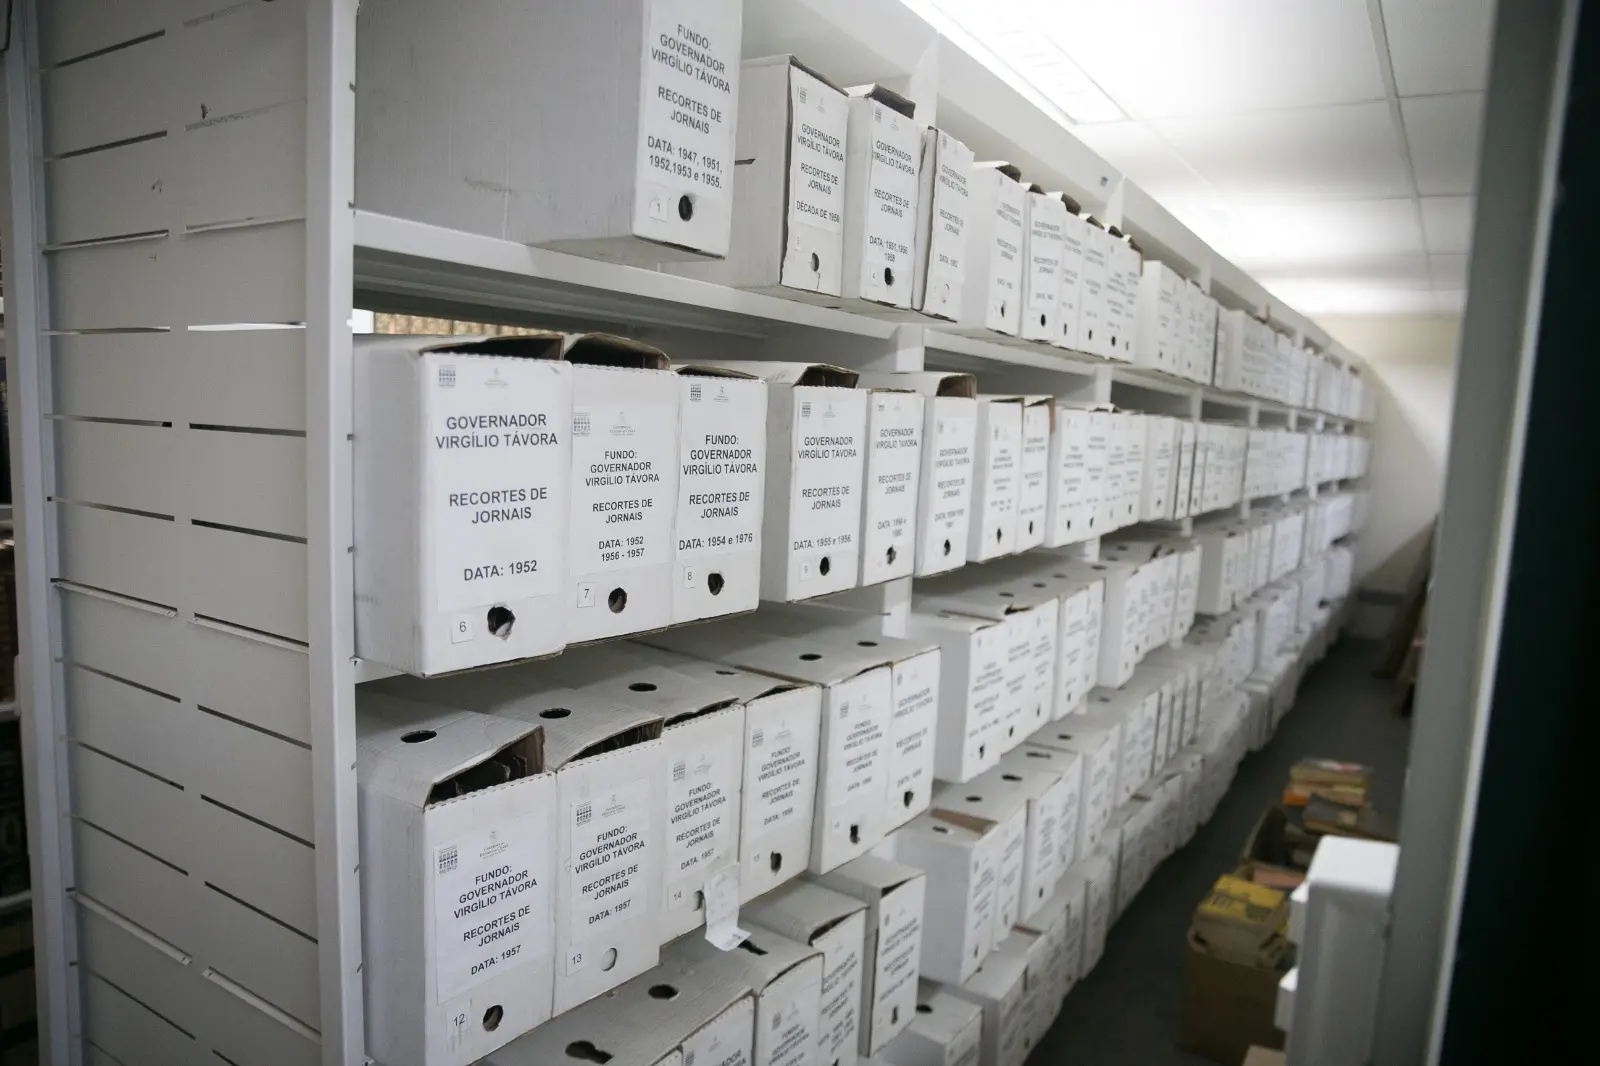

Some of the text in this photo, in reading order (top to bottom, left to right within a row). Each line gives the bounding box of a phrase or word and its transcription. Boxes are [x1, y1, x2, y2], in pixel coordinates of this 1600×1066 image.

[678, 24, 711, 51] FUNDO:
[660, 34, 724, 75] GOVERNADOR
[651, 47, 730, 94] VIRGÍLIO TÁVORA
[658, 85, 721, 123] RECORTES DE
[671, 109, 709, 134] JORNAIS
[801, 123, 840, 148] GOVERNADOR
[648, 136, 722, 174] DATA: 1947, 1951,
[876, 140, 912, 162] GOVERNADOR
[650, 155, 722, 189] 1952,1953 e 1955.
[801, 162, 839, 185] RECORTES DE
[808, 179, 831, 195] JORNAIS
[874, 188, 909, 209] RECORTES DE
[797, 200, 819, 216] DÉCADA
[820, 208, 827, 219] DE
[881, 204, 903, 218] JORNAIS
[446, 414, 547, 430] GOVERNADOR
[436, 430, 558, 449] VIRGÍLIO TÁVORA
[705, 434, 739, 445] FUNDO:
[804, 436, 853, 447] GOVERNADOR
[880, 428, 914, 438] GOVERNADOR
[604, 450, 638, 460] FUNDO:
[690, 449, 752, 461] GOVERNADOR
[798, 448, 830, 459] VIRGÍLIO
[590, 461, 652, 474] GOVERNADOR
[683, 461, 757, 475] VIRGÍLIO TÁVORA
[585, 472, 660, 487] VIRGÍLIO TÁVORA
[449, 487, 548, 507] RECORTES DE
[689, 491, 750, 505] RECORTES DE
[802, 485, 850, 498] RECORTES DE
[592, 498, 653, 513] RECORTES DE
[700, 506, 739, 519] JORNAIS
[811, 499, 841, 510] JORNAIS
[472, 506, 532, 524] JORNAIS
[605, 511, 643, 524] JORNAIS
[598, 536, 644, 550] DATA: 1952
[679, 532, 753, 551] DATA: 1954 e 1976
[794, 539, 814, 551] DATA:
[601, 551, 620, 562] 1956
[626, 548, 645, 559] 1957
[464, 560, 538, 581] DATA: 1952
[687, 571, 692, 581] 8
[584, 588, 590, 599] 7
[459, 621, 467, 633] 6
[761, 751, 801, 772] GOVERNADOR
[762, 778, 801, 799] RECORTES DE
[770, 790, 794, 805] JORNAIS
[674, 788, 721, 813] GOVERNADOR
[671, 807, 700, 824] VIRGÍLIO
[597, 825, 628, 843] FUNDO:
[676, 816, 721, 843] RECORTES DE
[579, 832, 638, 861] GOVERNADOR
[686, 830, 714, 849] JORNAIS
[575, 840, 645, 874] VIRGÍLIO TÁVORA
[681, 857, 700, 870] DATA:
[475, 865, 513, 885] FUNDO:
[582, 864, 639, 895] RECORTES DE
[459, 870, 529, 904] GOVERNADOR
[594, 879, 629, 901] JORNAIS
[454, 878, 538, 919] VIRGÍLIO TÁVORA
[588, 899, 632, 925] DATA: 1957
[463, 905, 531, 942] RECORTES DE
[478, 922, 520, 947] JORNAIS
[471, 944, 521, 976] DATA: 1957
[571, 953, 582, 965] 13
[454, 1013, 465, 1027] 12
